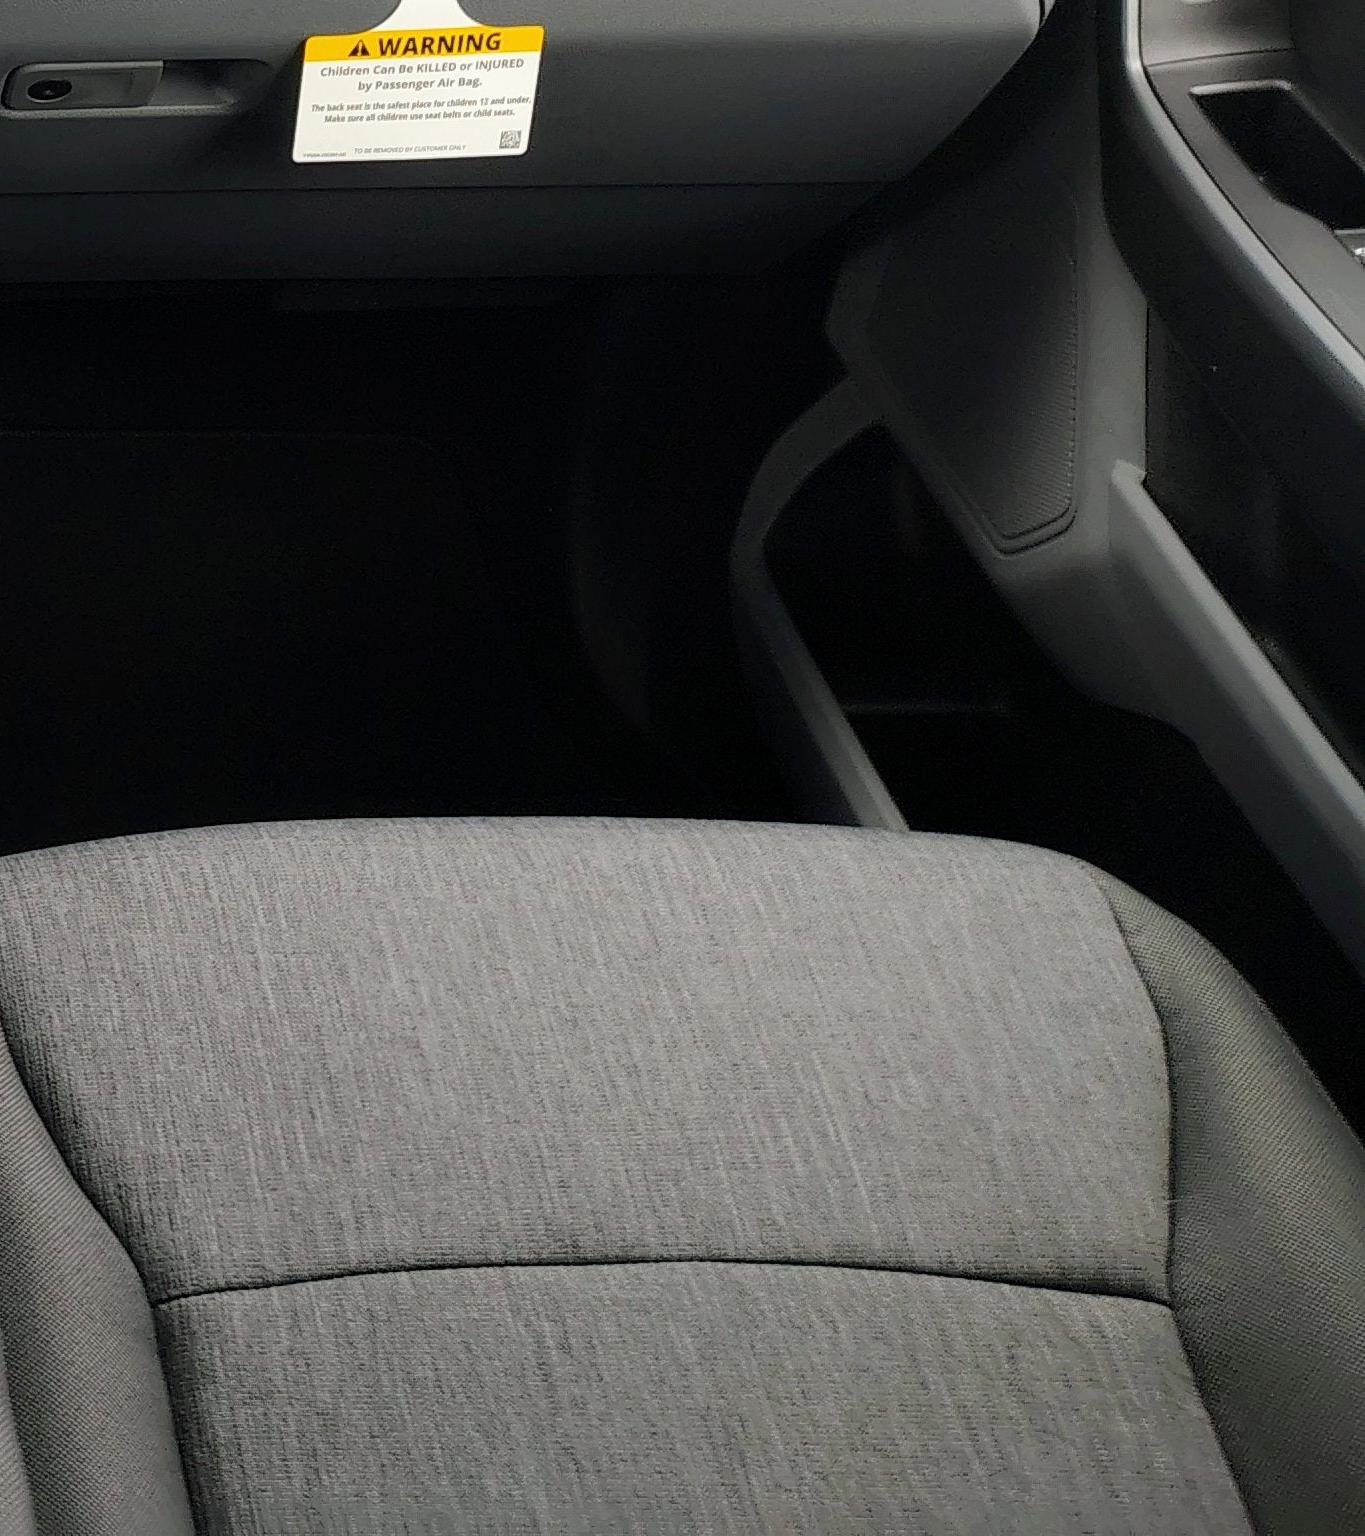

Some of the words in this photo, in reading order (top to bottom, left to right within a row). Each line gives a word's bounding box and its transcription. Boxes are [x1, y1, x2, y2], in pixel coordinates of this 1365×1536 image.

[378, 31, 502, 57] WARNING
[320, 65, 370, 77] Children
[373, 64, 396, 75] Can
[399, 64, 414, 74] Be
[416, 62, 457, 73] KILLED
[459, 62, 472, 71] or
[475, 57, 525, 72] INJURED
[357, 80, 373, 93] by
[375, 79, 436, 92] Passenger
[437, 77, 456, 88] Air
[458, 76, 483, 89] Bag.
[311, 103, 325, 113] The
[327, 102, 345, 112] back
[346, 103, 363, 112] seat
[372, 102, 386, 111] the
[387, 100, 410, 110] safest
[411, 100, 432, 111] place
[433, 99, 445, 109] for
[446, 97, 478, 107] children
[480, 97, 489, 106] 12
[490, 96, 506, 105] and
[324, 114, 346, 124] Make
[347, 115, 364, 123] sure
[365, 113, 376, 122] all
[376, 112, 408, 122] children
[424, 111, 442, 120] seat
[443, 110, 462, 119] belts
[473, 108, 493, 118] child
